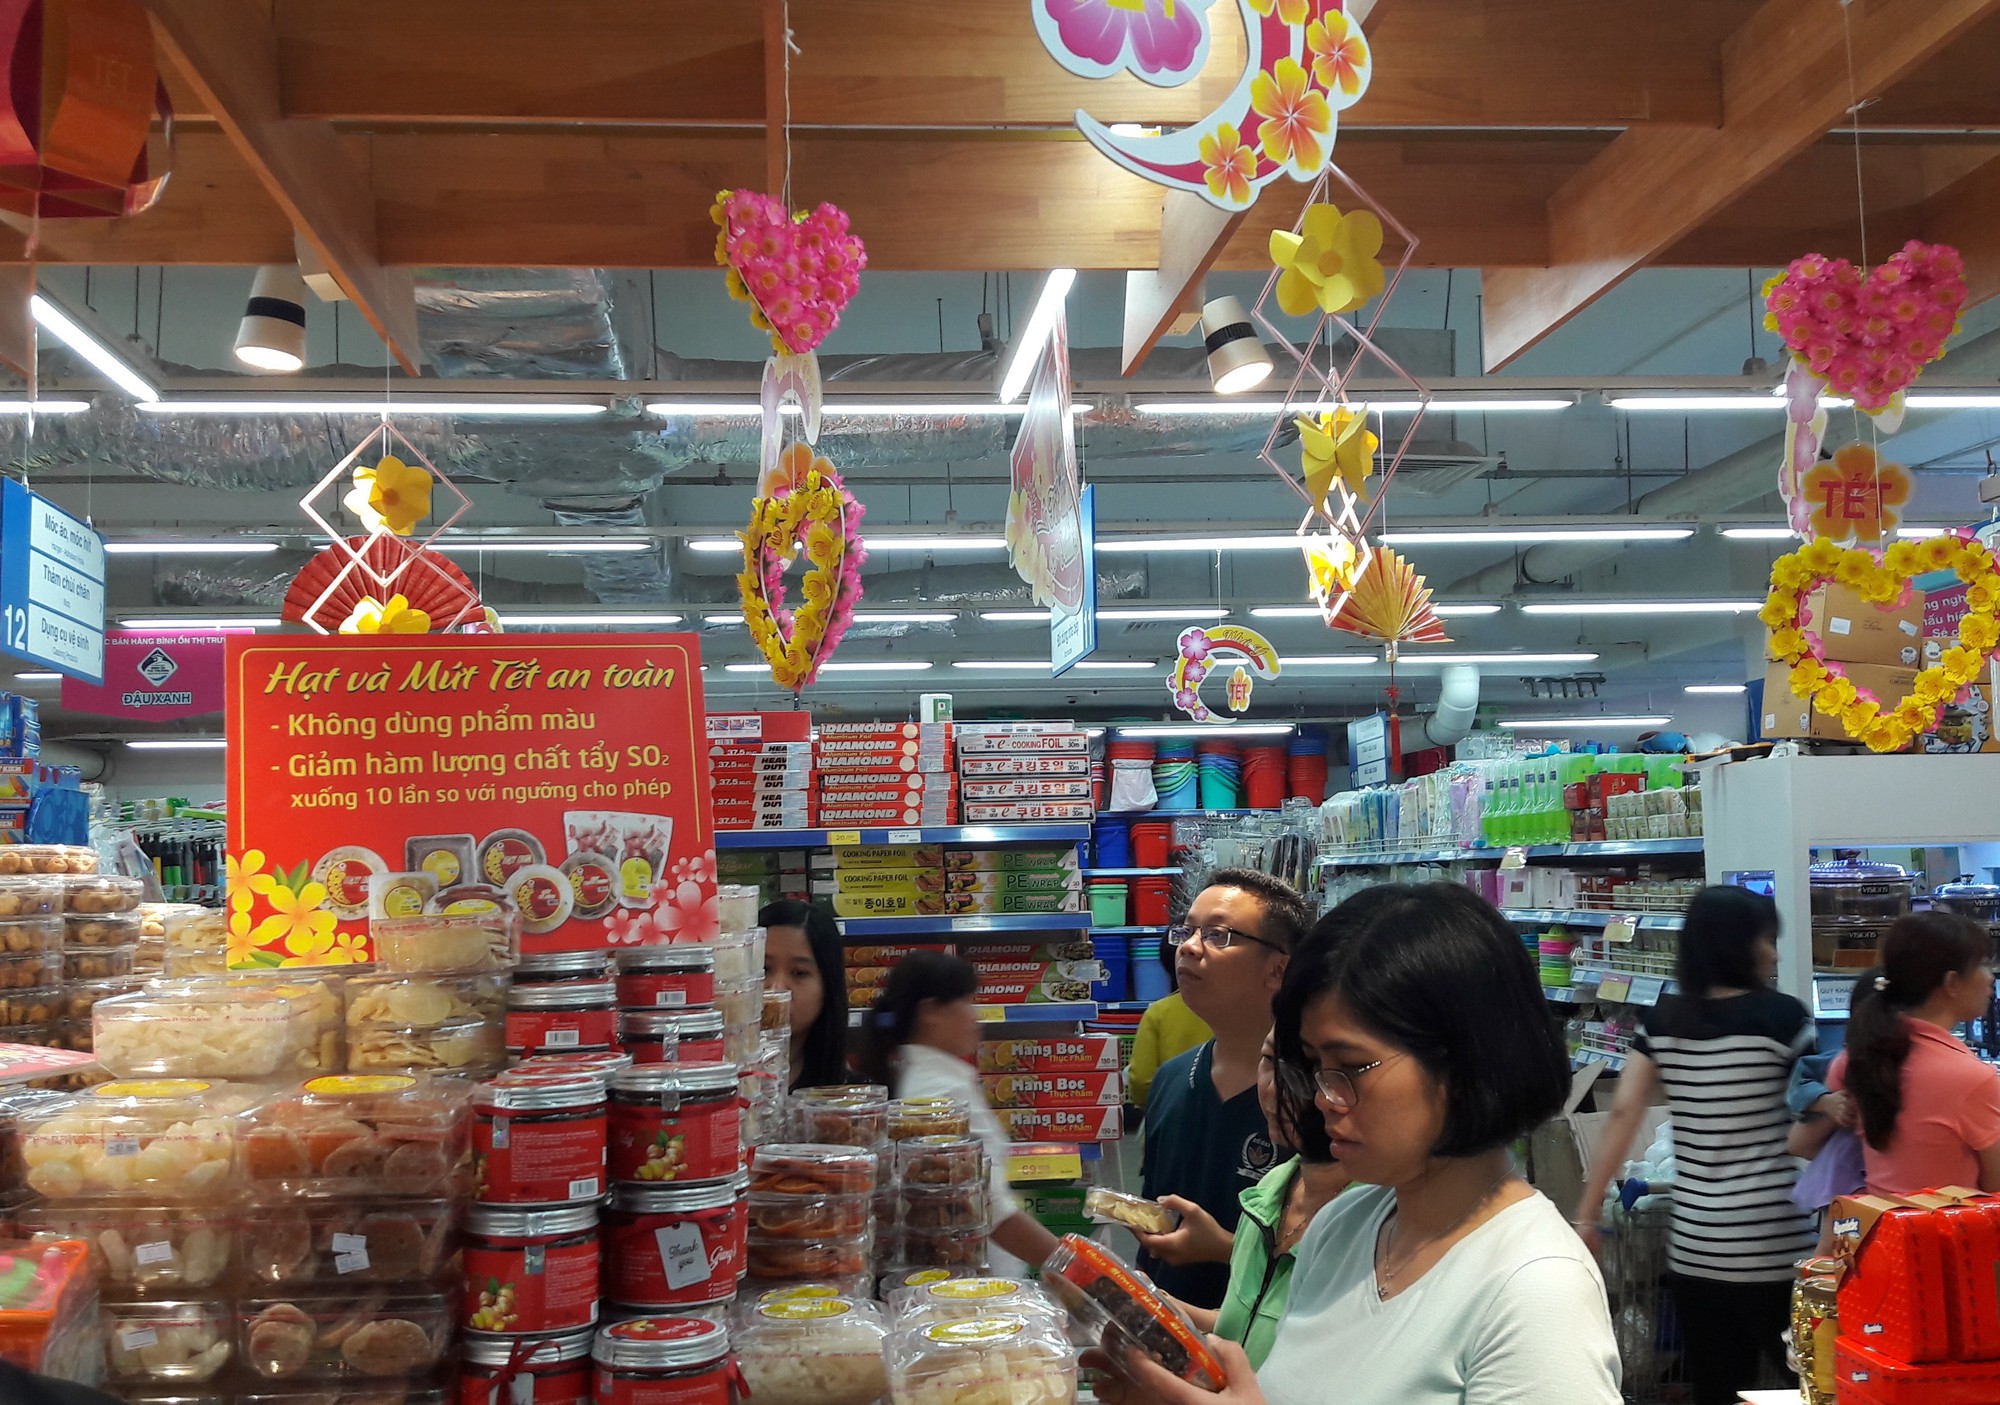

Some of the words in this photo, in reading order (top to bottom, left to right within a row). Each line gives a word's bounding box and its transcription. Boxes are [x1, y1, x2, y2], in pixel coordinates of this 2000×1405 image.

[1819, 472, 1892, 519] TẾT
[1942, 594, 1966, 607] ngh
[5, 604, 26, 650] 12
[41, 617, 58, 642] Dụng
[131, 637, 154, 645] HÀNG
[156, 635, 177, 645] BÌNH
[191, 637, 205, 646] THỊ
[205, 636, 226, 644] TRƯ
[263, 661, 341, 701] Hạt
[346, 661, 392, 693] và
[398, 659, 479, 693] Mứt
[489, 657, 541, 692] Tết
[546, 668, 592, 690] an
[602, 658, 676, 690] toàn
[122, 690, 152, 708] ĐẬU
[153, 691, 192, 705] XANH
[288, 712, 377, 740] Không
[384, 711, 453, 738] dùng
[461, 703, 533, 737] phẩm
[541, 708, 596, 731] màu
[825, 724, 896, 733] DIAMOND
[825, 741, 896, 750] DIAMOND
[1012, 741, 1041, 749] COOKING
[288, 751, 358, 777] Giảm
[366, 751, 424, 775] hàm
[432, 750, 506, 777] lượng
[514, 744, 572, 770] chất
[578, 740, 620, 773] tẩy
[820, 756, 894, 766] DIAMOND
[1012, 761, 1064, 772] 쿠킹호일
[828, 774, 901, 784] DIAMOND
[291, 786, 358, 810] xuống
[366, 787, 393, 805] 10
[399, 784, 430, 804] lần
[436, 789, 460, 802] so
[465, 783, 496, 801] với
[502, 781, 578, 804] ngưỡng
[583, 780, 618, 797] cho
[623, 778, 672, 800] phép
[1014, 784, 1065, 795] 쿠킹호일
[825, 792, 898, 801] DIAMOND
[824, 809, 897, 819] DIAMOND
[1017, 806, 1068, 817] 쿠킹호일
[1003, 854, 1025, 867] PE
[873, 874, 894, 882] PAPER
[1007, 874, 1028, 888] PE
[1031, 880, 1060, 888] WRAP
[864, 897, 906, 910] 종이호일
[1003, 896, 1024, 910] PE
[1028, 901, 1056, 909] WRAP
[968, 945, 1031, 953] DIAMOND
[978, 963, 1041, 972] DIAMOND
[976, 985, 1025, 994] AMOND
[1024, 1198, 1046, 1213] PE
[669, 1239, 698, 1259] Thank
